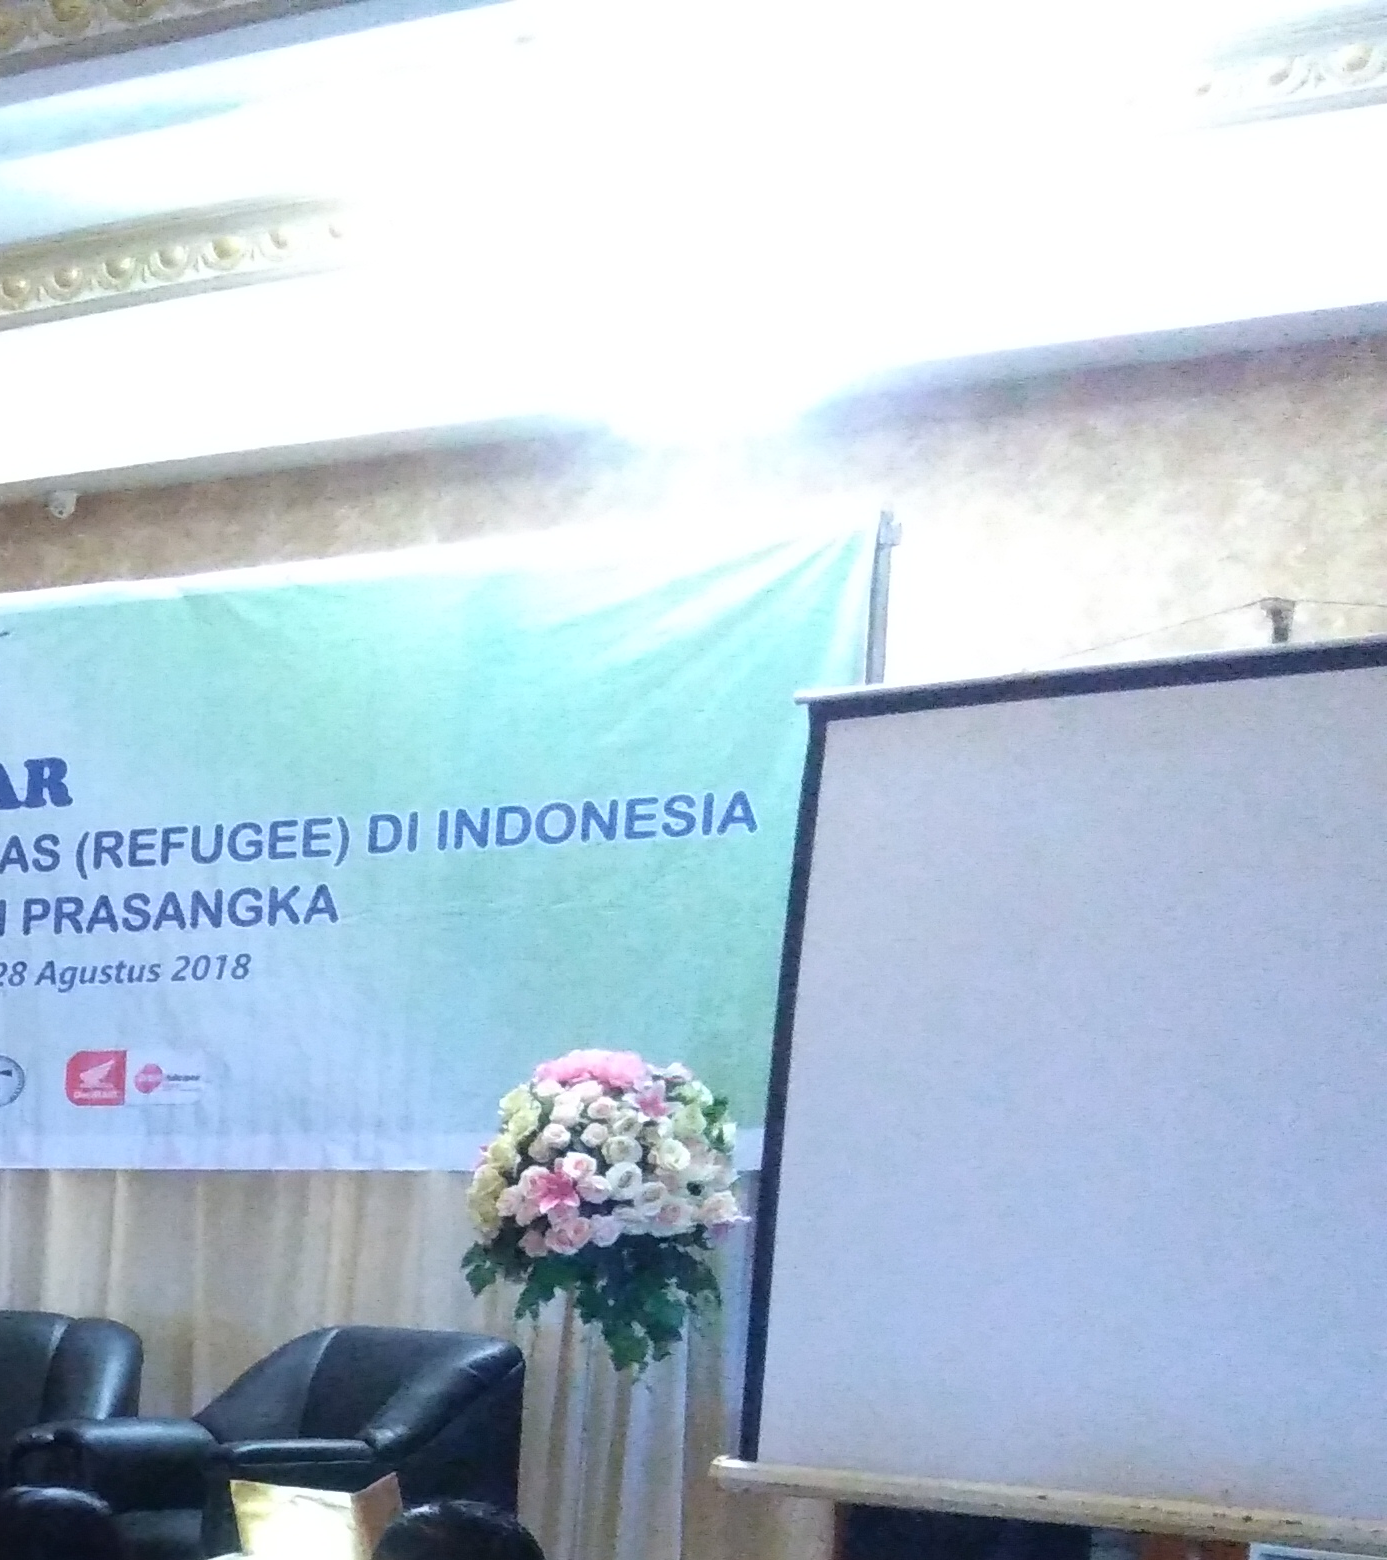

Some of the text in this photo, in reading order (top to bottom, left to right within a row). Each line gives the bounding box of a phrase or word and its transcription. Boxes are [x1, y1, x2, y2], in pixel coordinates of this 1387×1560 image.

[75, 816, 350, 881] (REFUGEE)
[367, 812, 419, 855] DI
[437, 791, 758, 851] INDONESIA
[21, 883, 340, 936] PRASANGKA
[33, 960, 162, 993] Agustus
[170, 952, 252, 985] 2018
